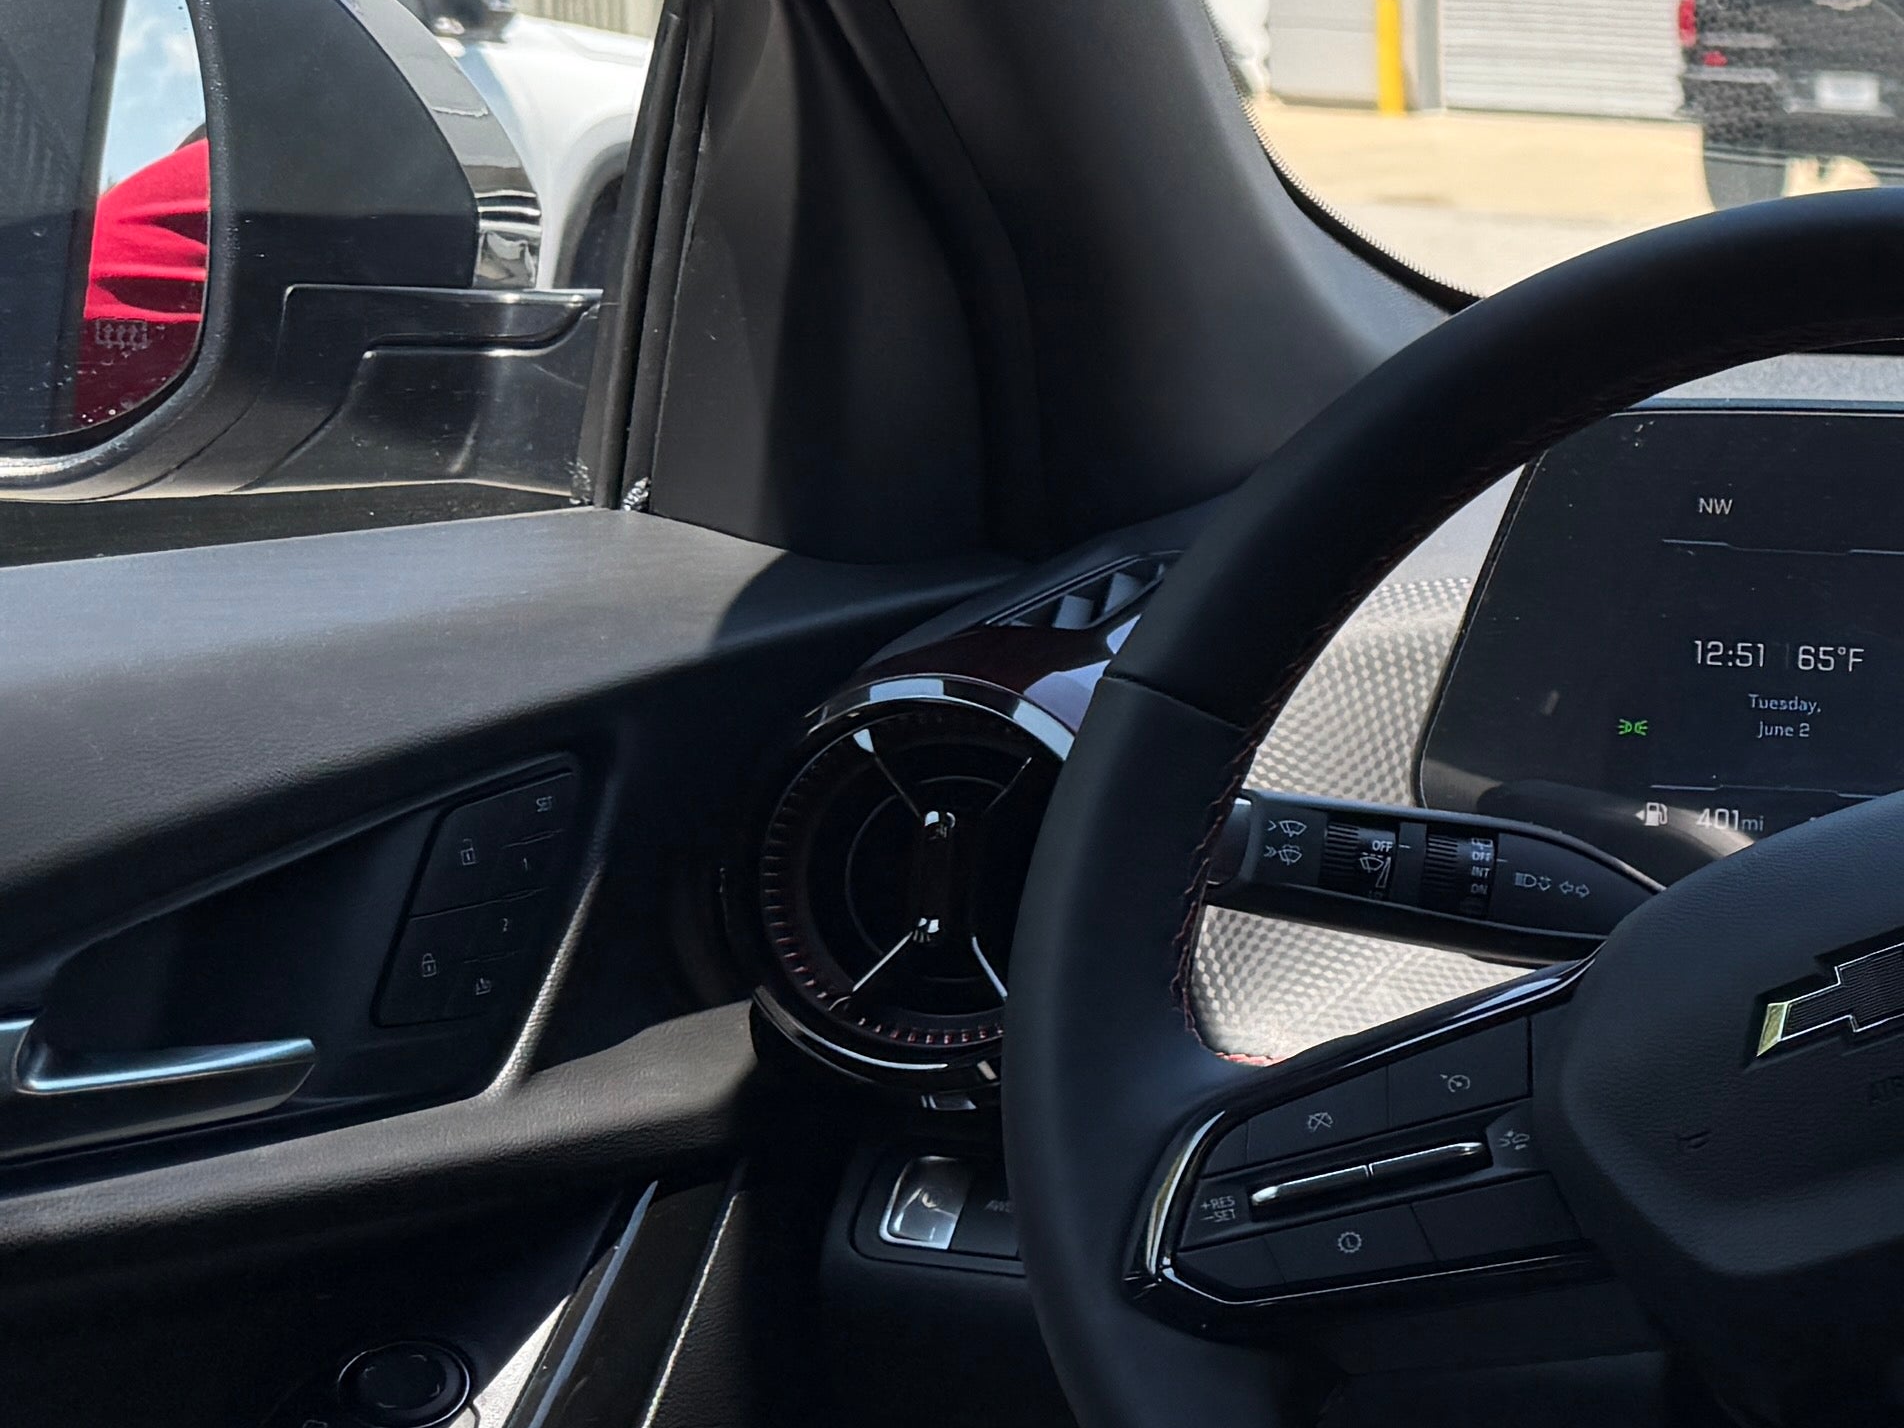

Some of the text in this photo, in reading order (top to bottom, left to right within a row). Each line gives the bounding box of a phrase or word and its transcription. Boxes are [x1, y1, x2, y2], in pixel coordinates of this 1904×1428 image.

[1699, 497, 1732, 514] NW
[1694, 640, 1864, 672] 12:51 65°F
[1748, 693, 1821, 716] Tuesday,
[1757, 722, 1810, 739] June 2
[1372, 840, 1393, 852] OFF
[1471, 852, 1491, 862] OFF
[1472, 867, 1489, 878] INT
